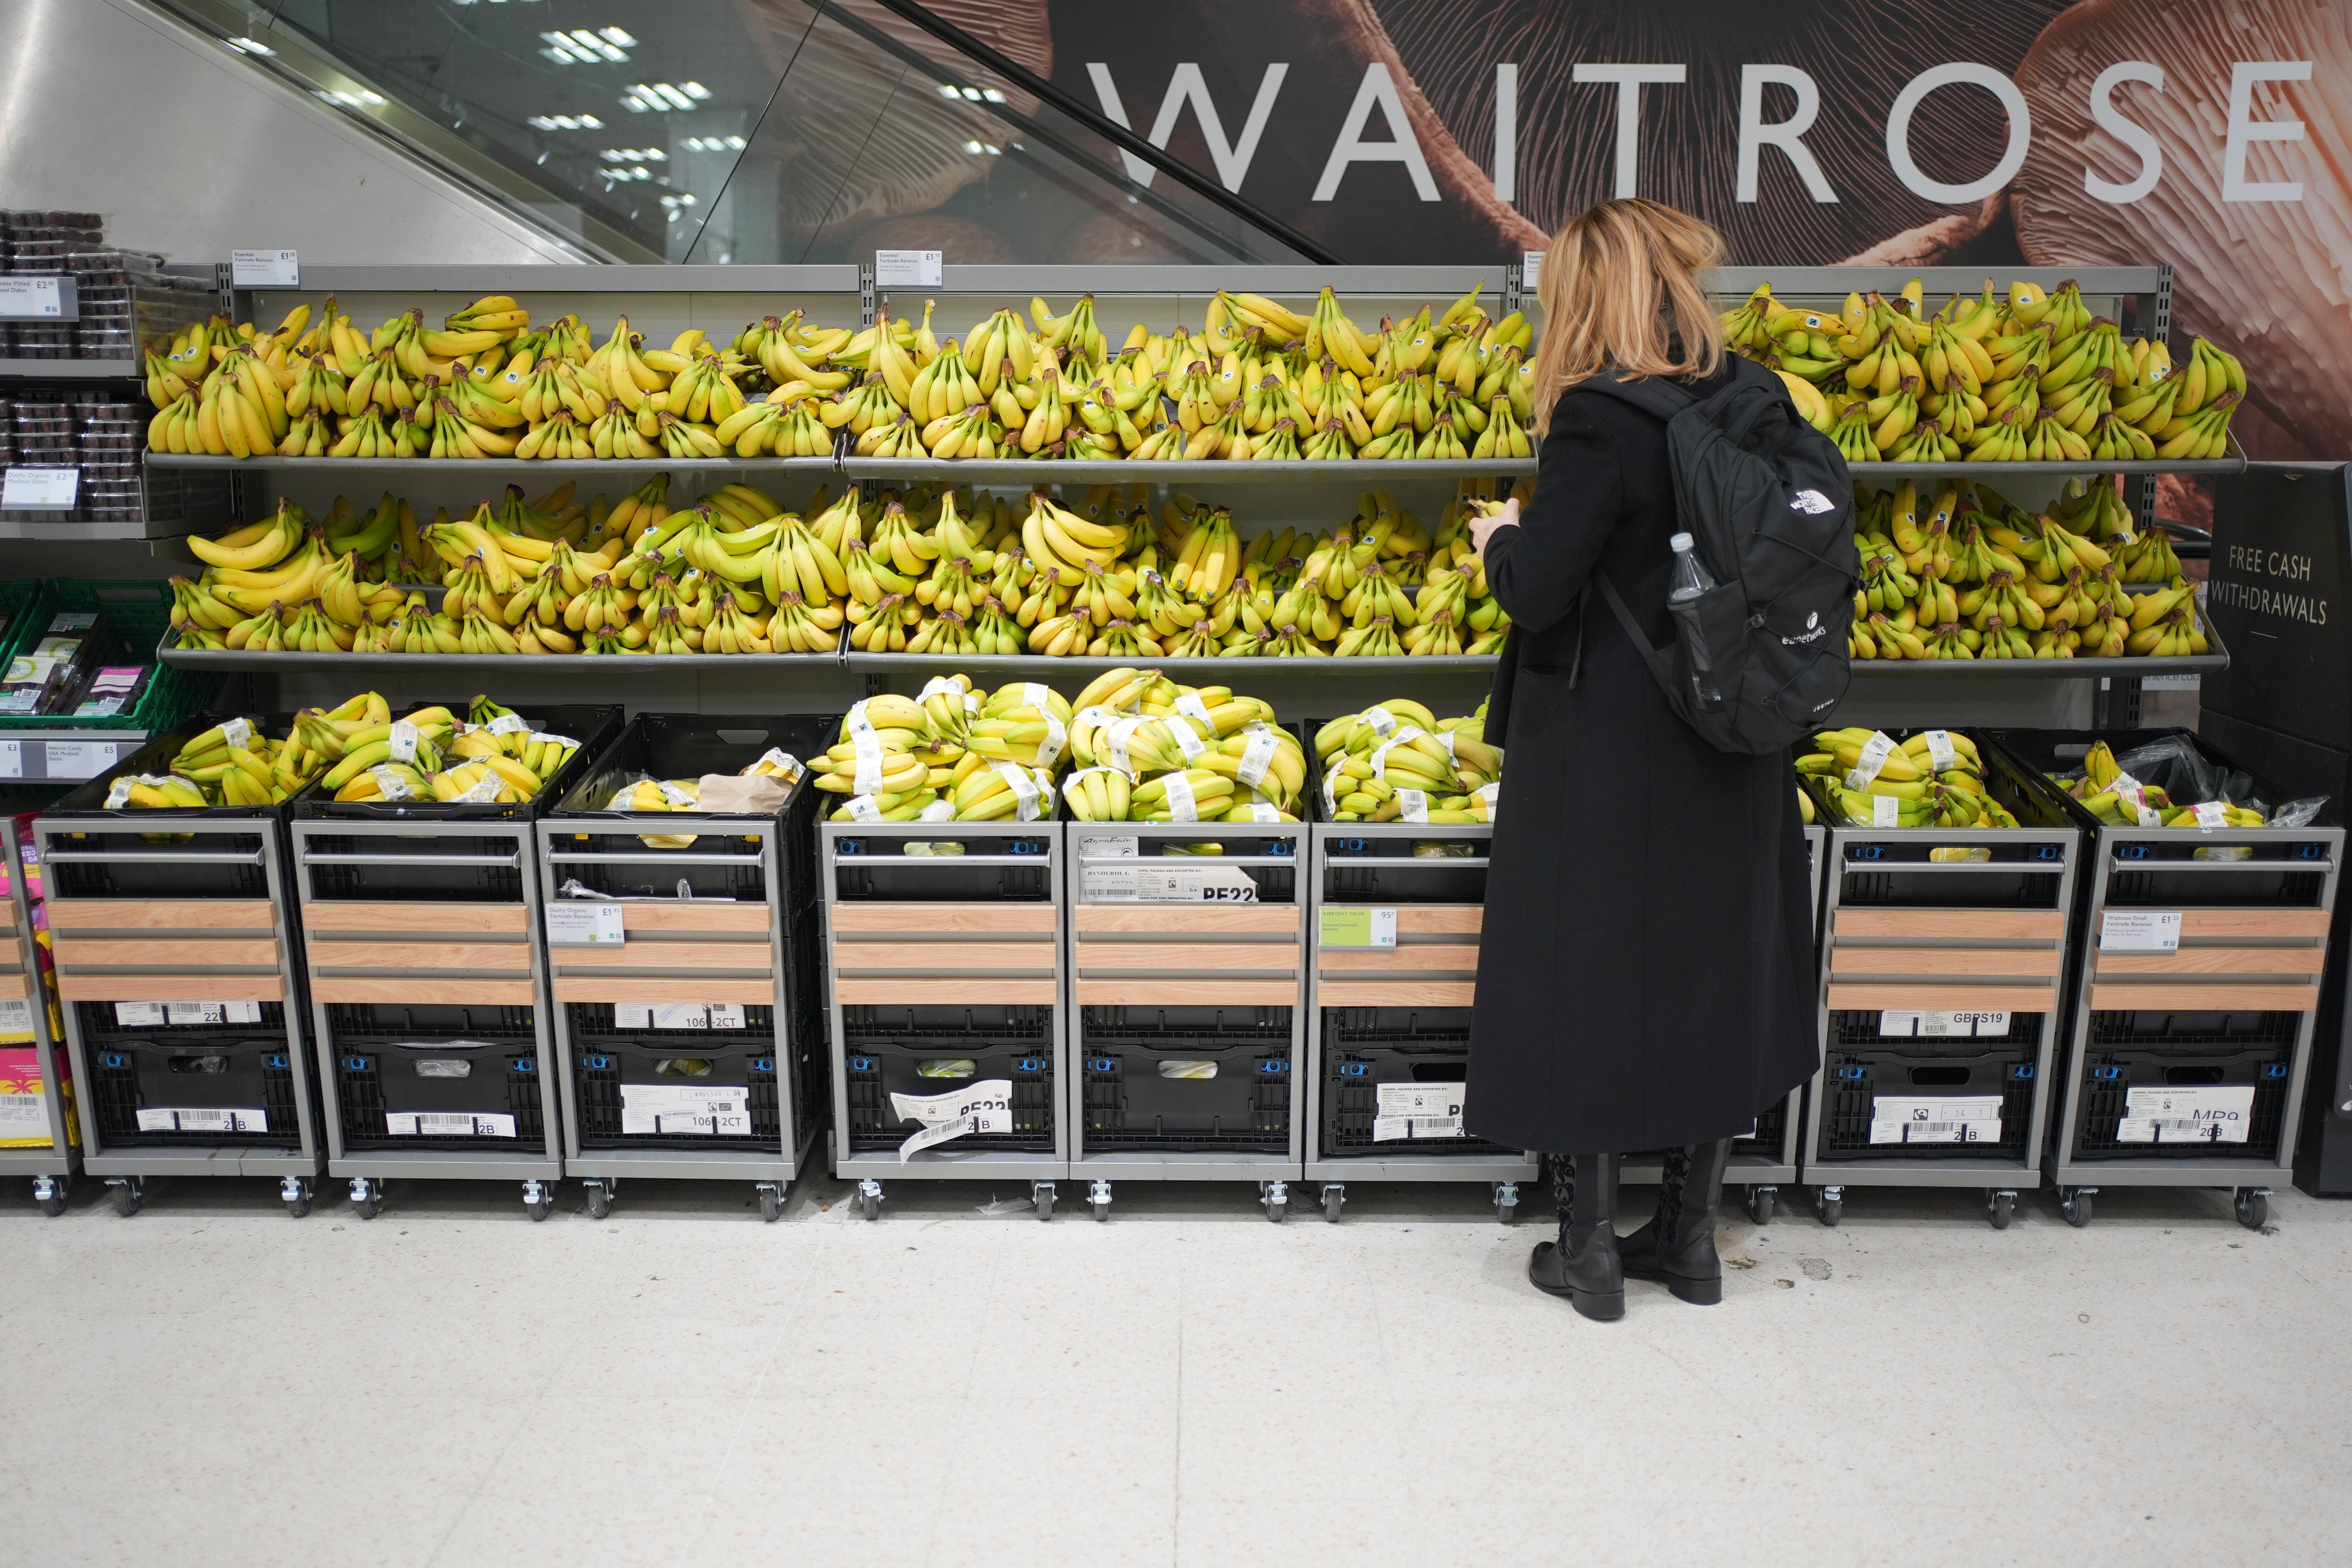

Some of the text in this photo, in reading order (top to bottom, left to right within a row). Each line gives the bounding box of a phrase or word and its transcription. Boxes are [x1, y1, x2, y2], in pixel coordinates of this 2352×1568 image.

[1085, 61, 2313, 204] WAITROSE
[1796, 490, 1812, 499] THE
[1790, 498, 1815, 510] NORTH
[1804, 505, 1822, 515] FACE
[2230, 545, 2311, 581] FREE CASH
[2211, 579, 2327, 625] WITHDRAWALS
[1083, 837, 1131, 845] AgroFair
[686, 1018, 736, 1027] 106-2CT
[1954, 1013, 2002, 1023] GBPS19
[692, 1117, 741, 1126] 106-2CT
